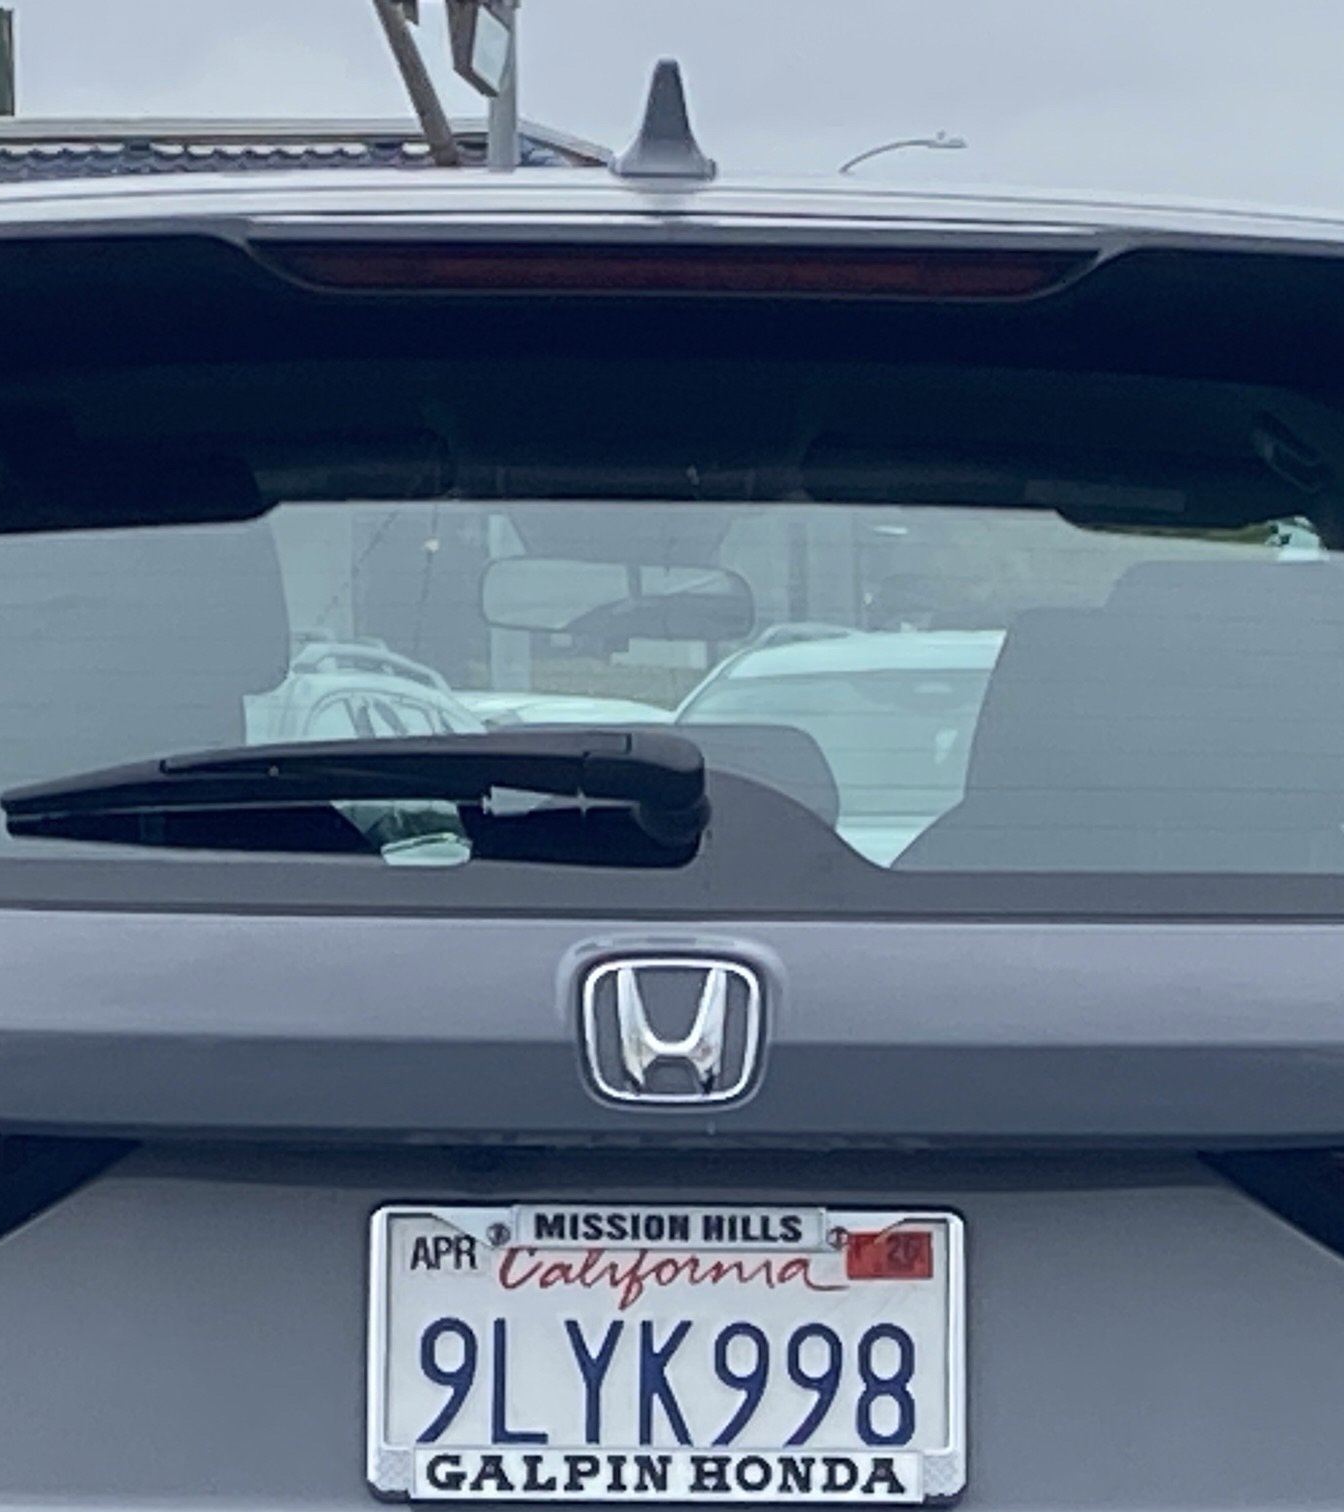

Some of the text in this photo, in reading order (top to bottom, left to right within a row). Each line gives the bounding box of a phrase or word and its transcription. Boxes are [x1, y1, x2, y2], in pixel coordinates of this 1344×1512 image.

[534, 1212, 804, 1244] MISSION HILLS
[410, 1235, 478, 1271] APR
[497, 1247, 851, 1311] California
[416, 1317, 917, 1447] 9LYK998
[425, 1453, 906, 1495] GALPIN HONDA
